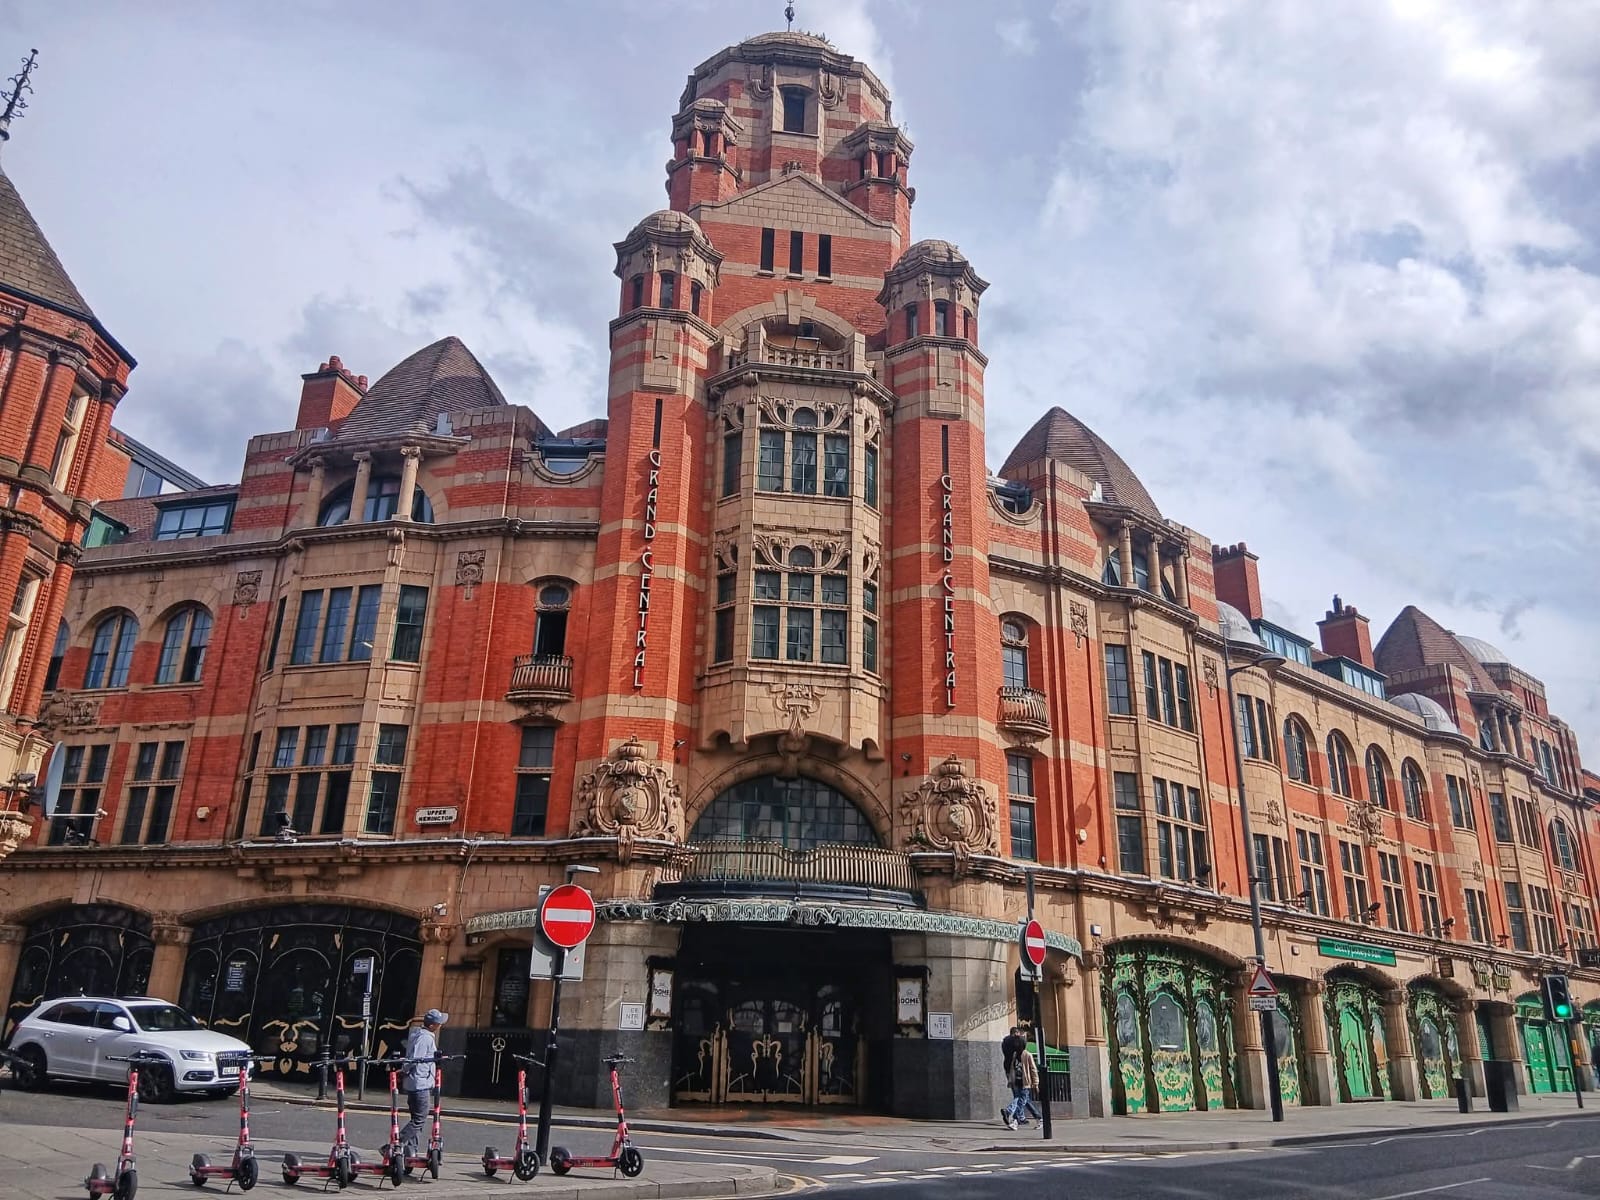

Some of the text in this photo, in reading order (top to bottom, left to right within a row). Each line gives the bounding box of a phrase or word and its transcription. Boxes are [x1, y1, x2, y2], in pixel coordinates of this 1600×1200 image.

[633, 450, 661, 688] GRAND CENTRAL
[941, 474, 956, 707] GRAND CENTRAL
